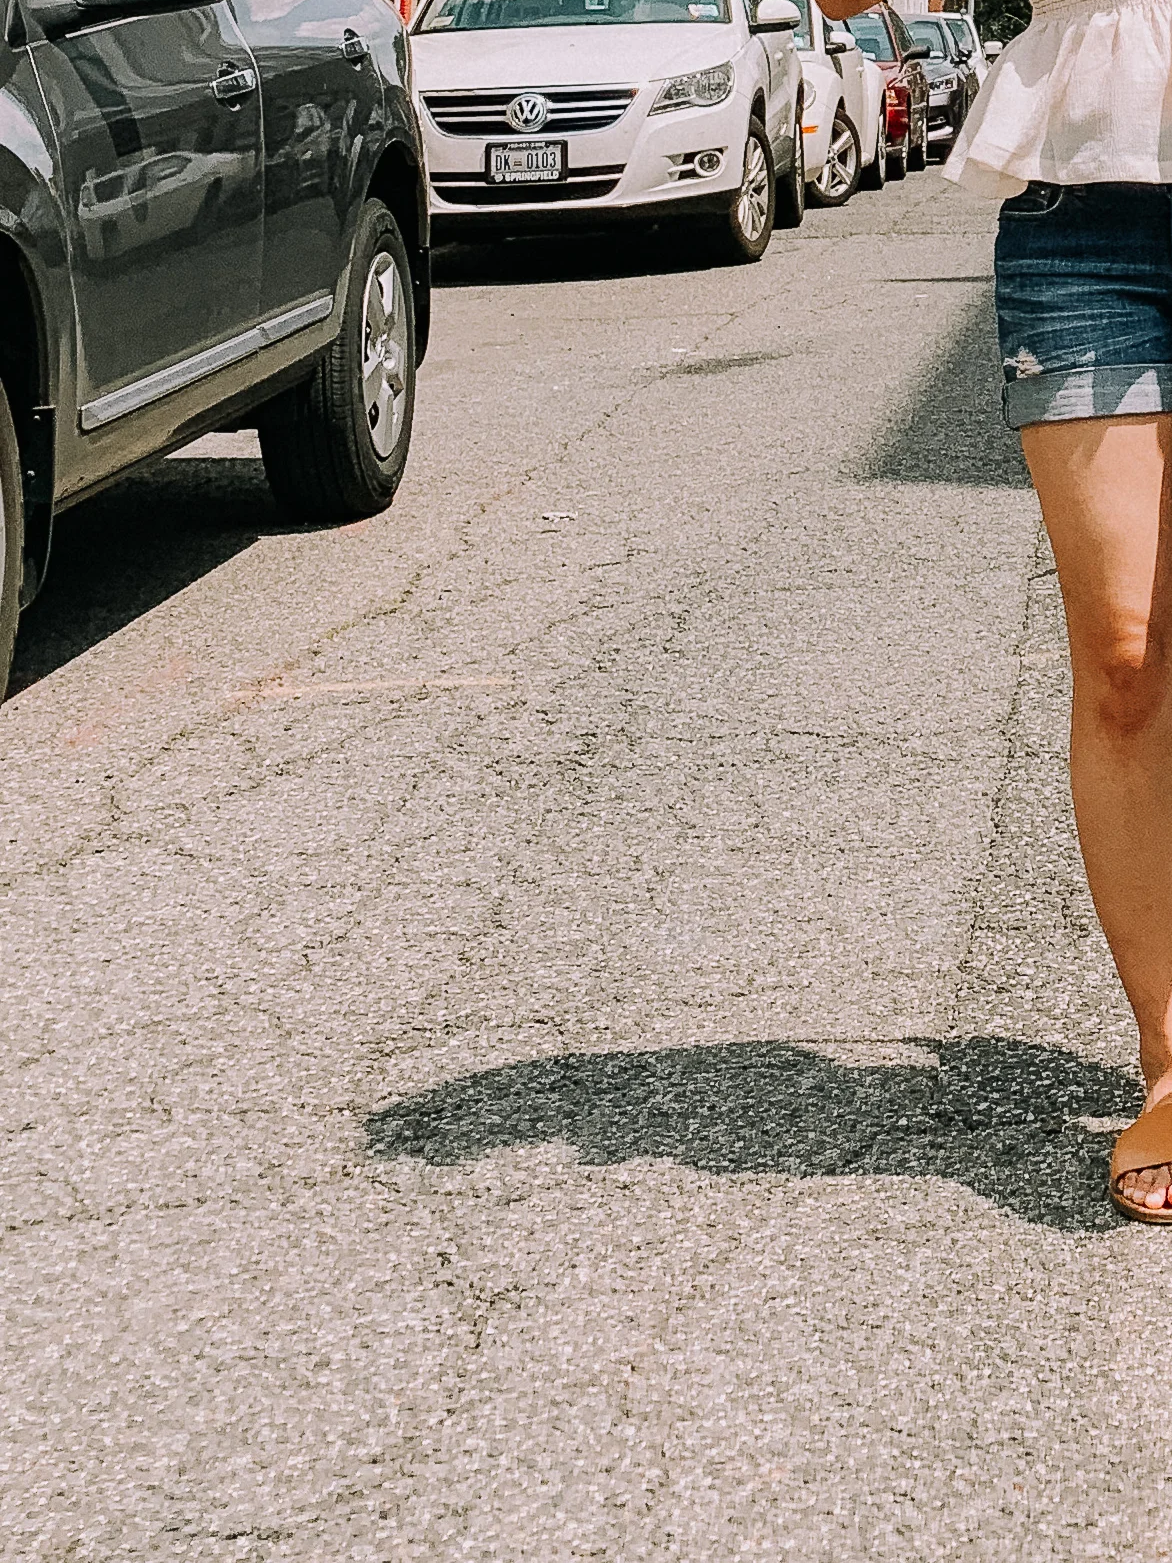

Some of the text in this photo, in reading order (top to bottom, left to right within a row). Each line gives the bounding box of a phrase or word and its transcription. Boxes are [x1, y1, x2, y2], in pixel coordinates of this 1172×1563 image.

[495, 152, 557, 171] DK 0103
[505, 170, 559, 182] SPRINGFIELD
